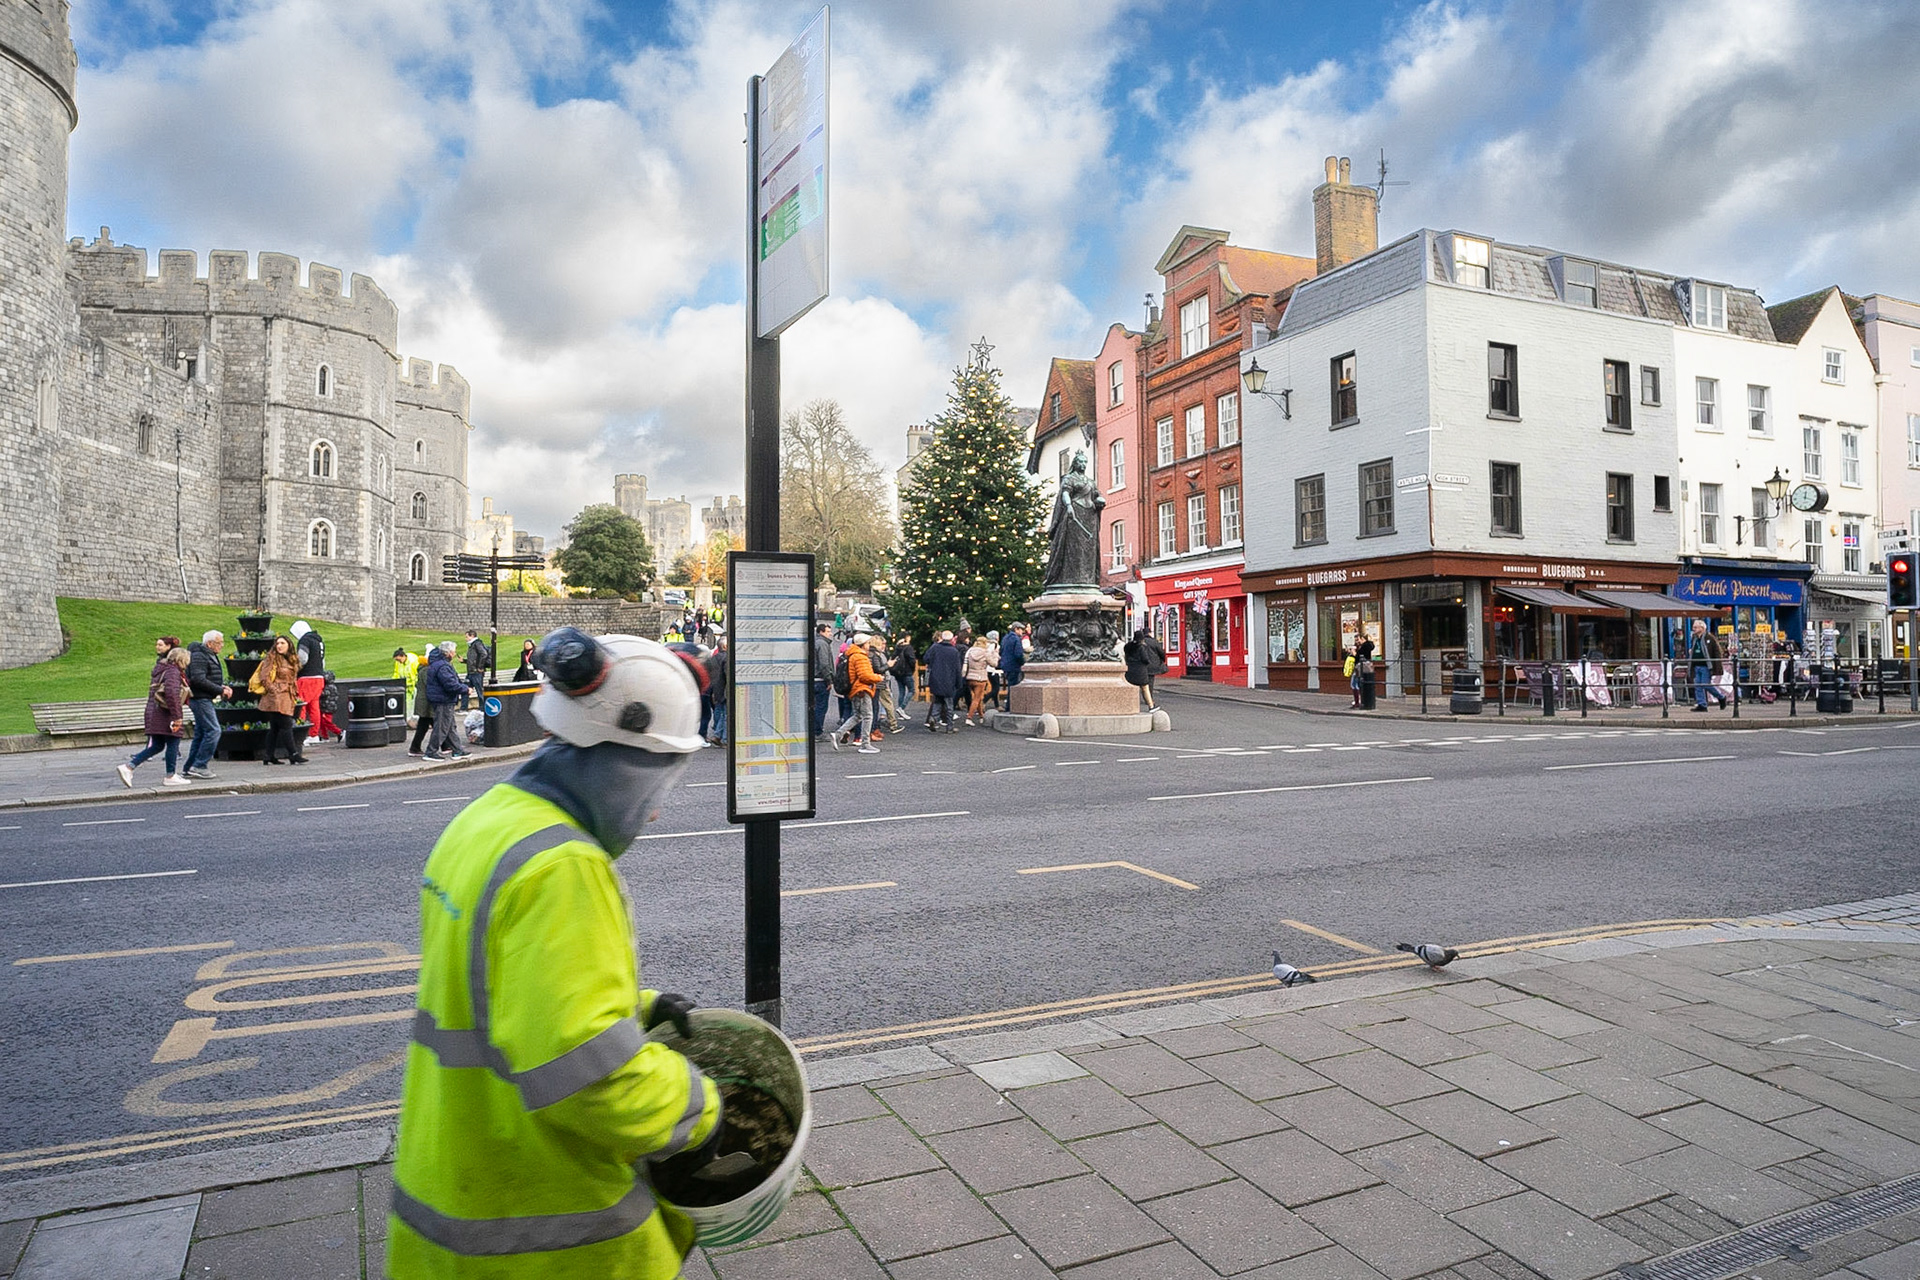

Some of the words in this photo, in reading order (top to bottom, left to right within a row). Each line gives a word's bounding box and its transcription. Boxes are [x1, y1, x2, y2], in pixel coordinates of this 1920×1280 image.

[1307, 569, 1347, 585] BLUEGRASS
[1542, 564, 1586, 578] BLUEGRASS
[1682, 579, 1695, 596] A
[1697, 579, 1727, 596] Little
[1731, 580, 1771, 600] Present
